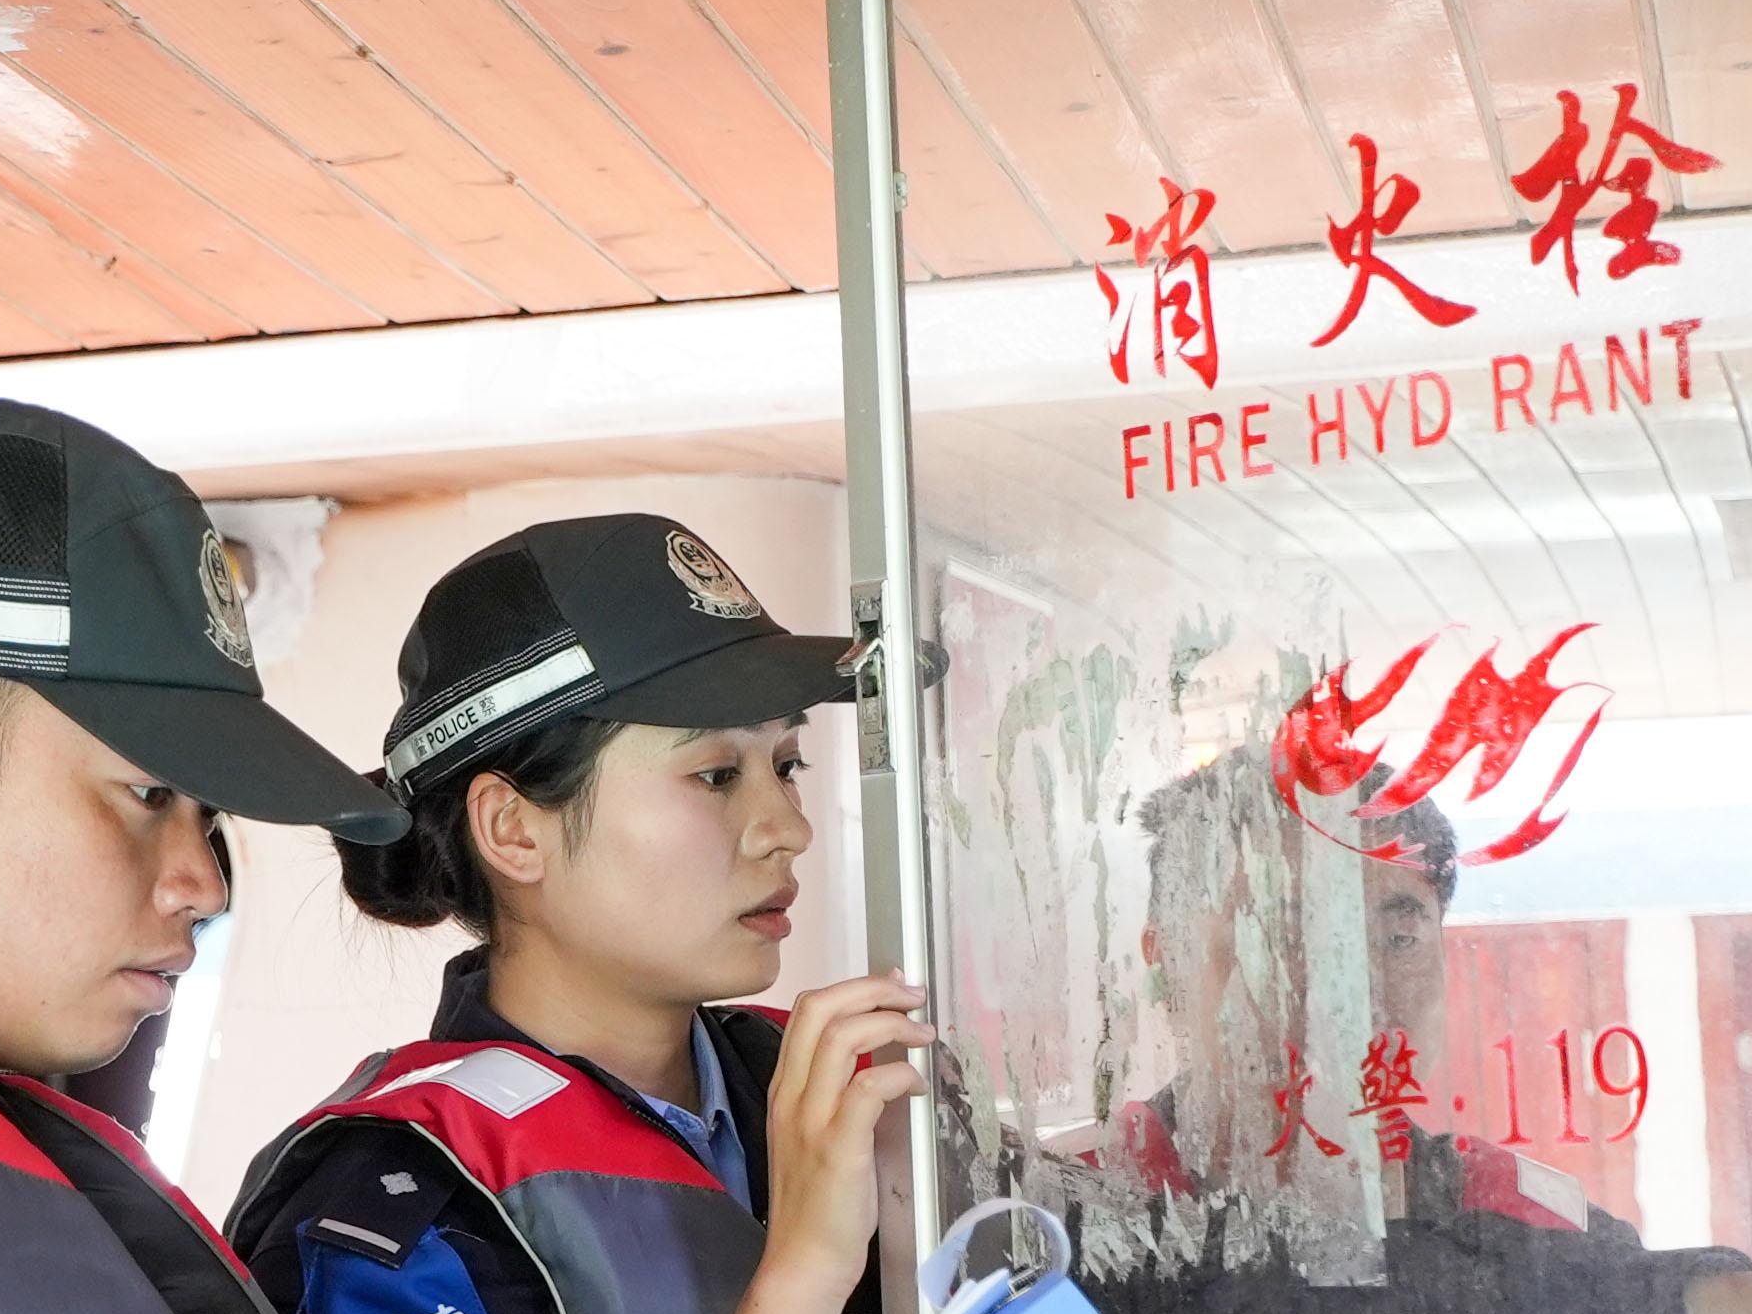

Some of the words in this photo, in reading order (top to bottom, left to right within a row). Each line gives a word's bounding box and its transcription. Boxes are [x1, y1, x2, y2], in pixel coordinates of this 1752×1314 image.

[1095, 82, 1722, 389] 消火栓
[1122, 401, 1274, 501] FIRE
[1307, 369, 1453, 467] HYD
[1491, 318, 1703, 435] RANT
[426, 707, 479, 749] POLICE
